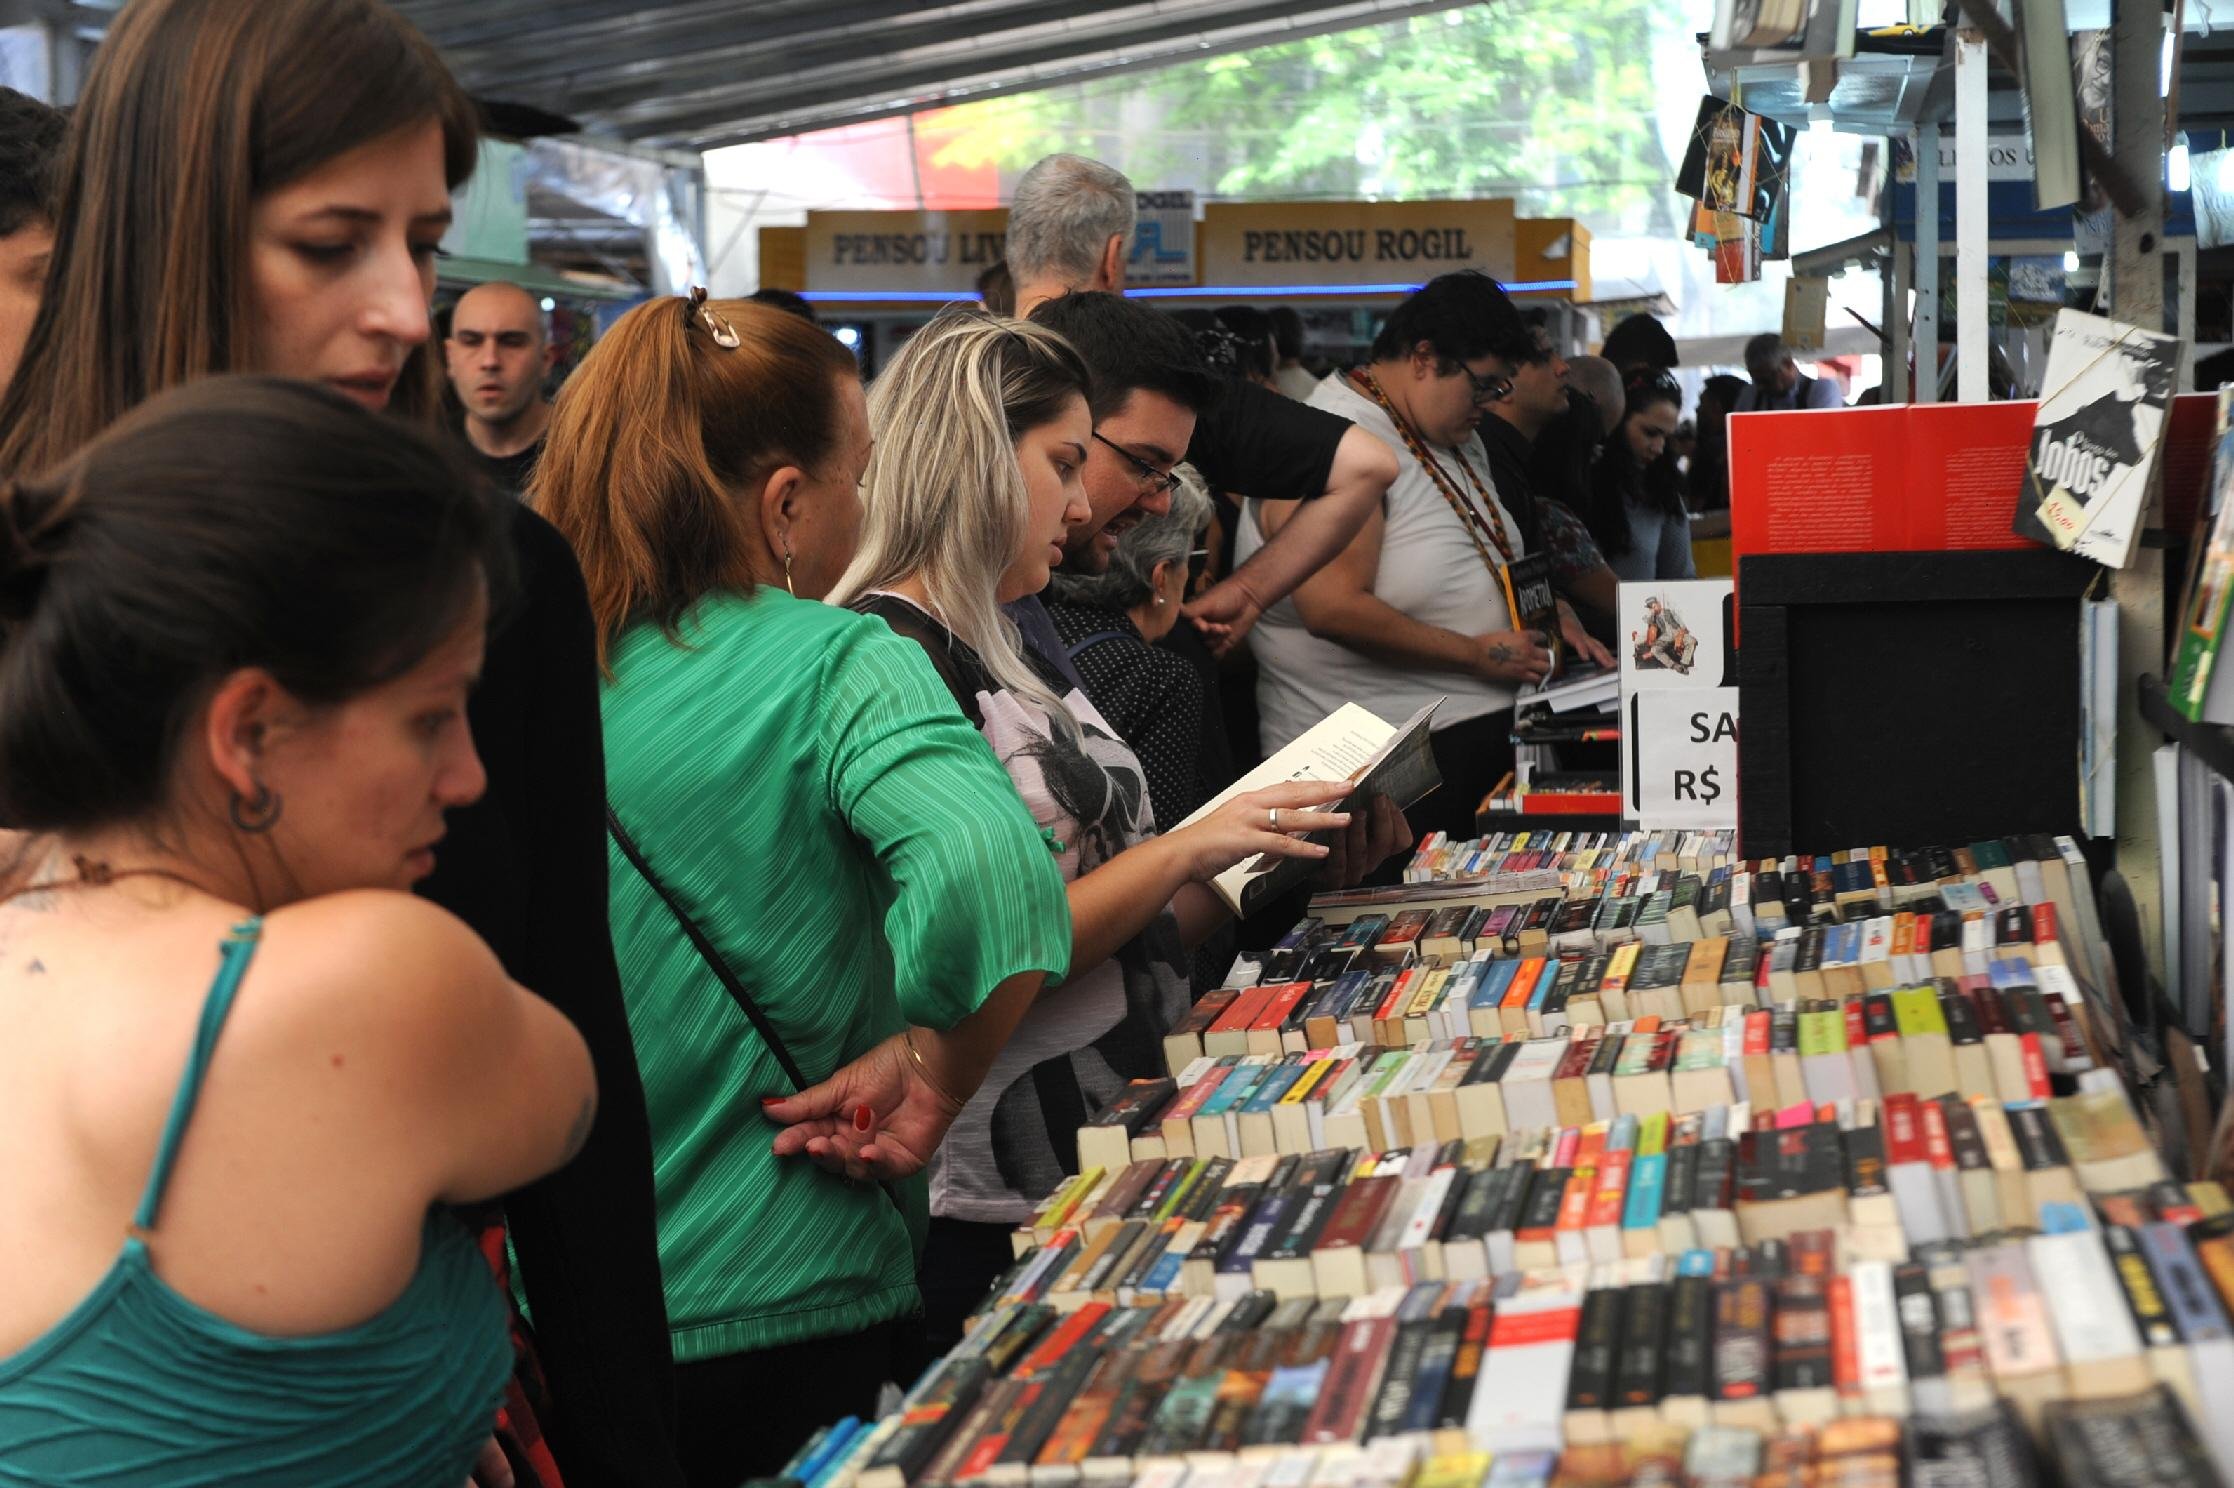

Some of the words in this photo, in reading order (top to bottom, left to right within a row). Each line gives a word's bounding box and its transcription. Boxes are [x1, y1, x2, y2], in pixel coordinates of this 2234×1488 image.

[832, 232, 948, 265] PENSOU
[1242, 229, 1367, 263] PENSOU
[1374, 228, 1474, 261] ROGIL
[1690, 711, 1738, 743] SA
[1674, 764, 1721, 806] R$
